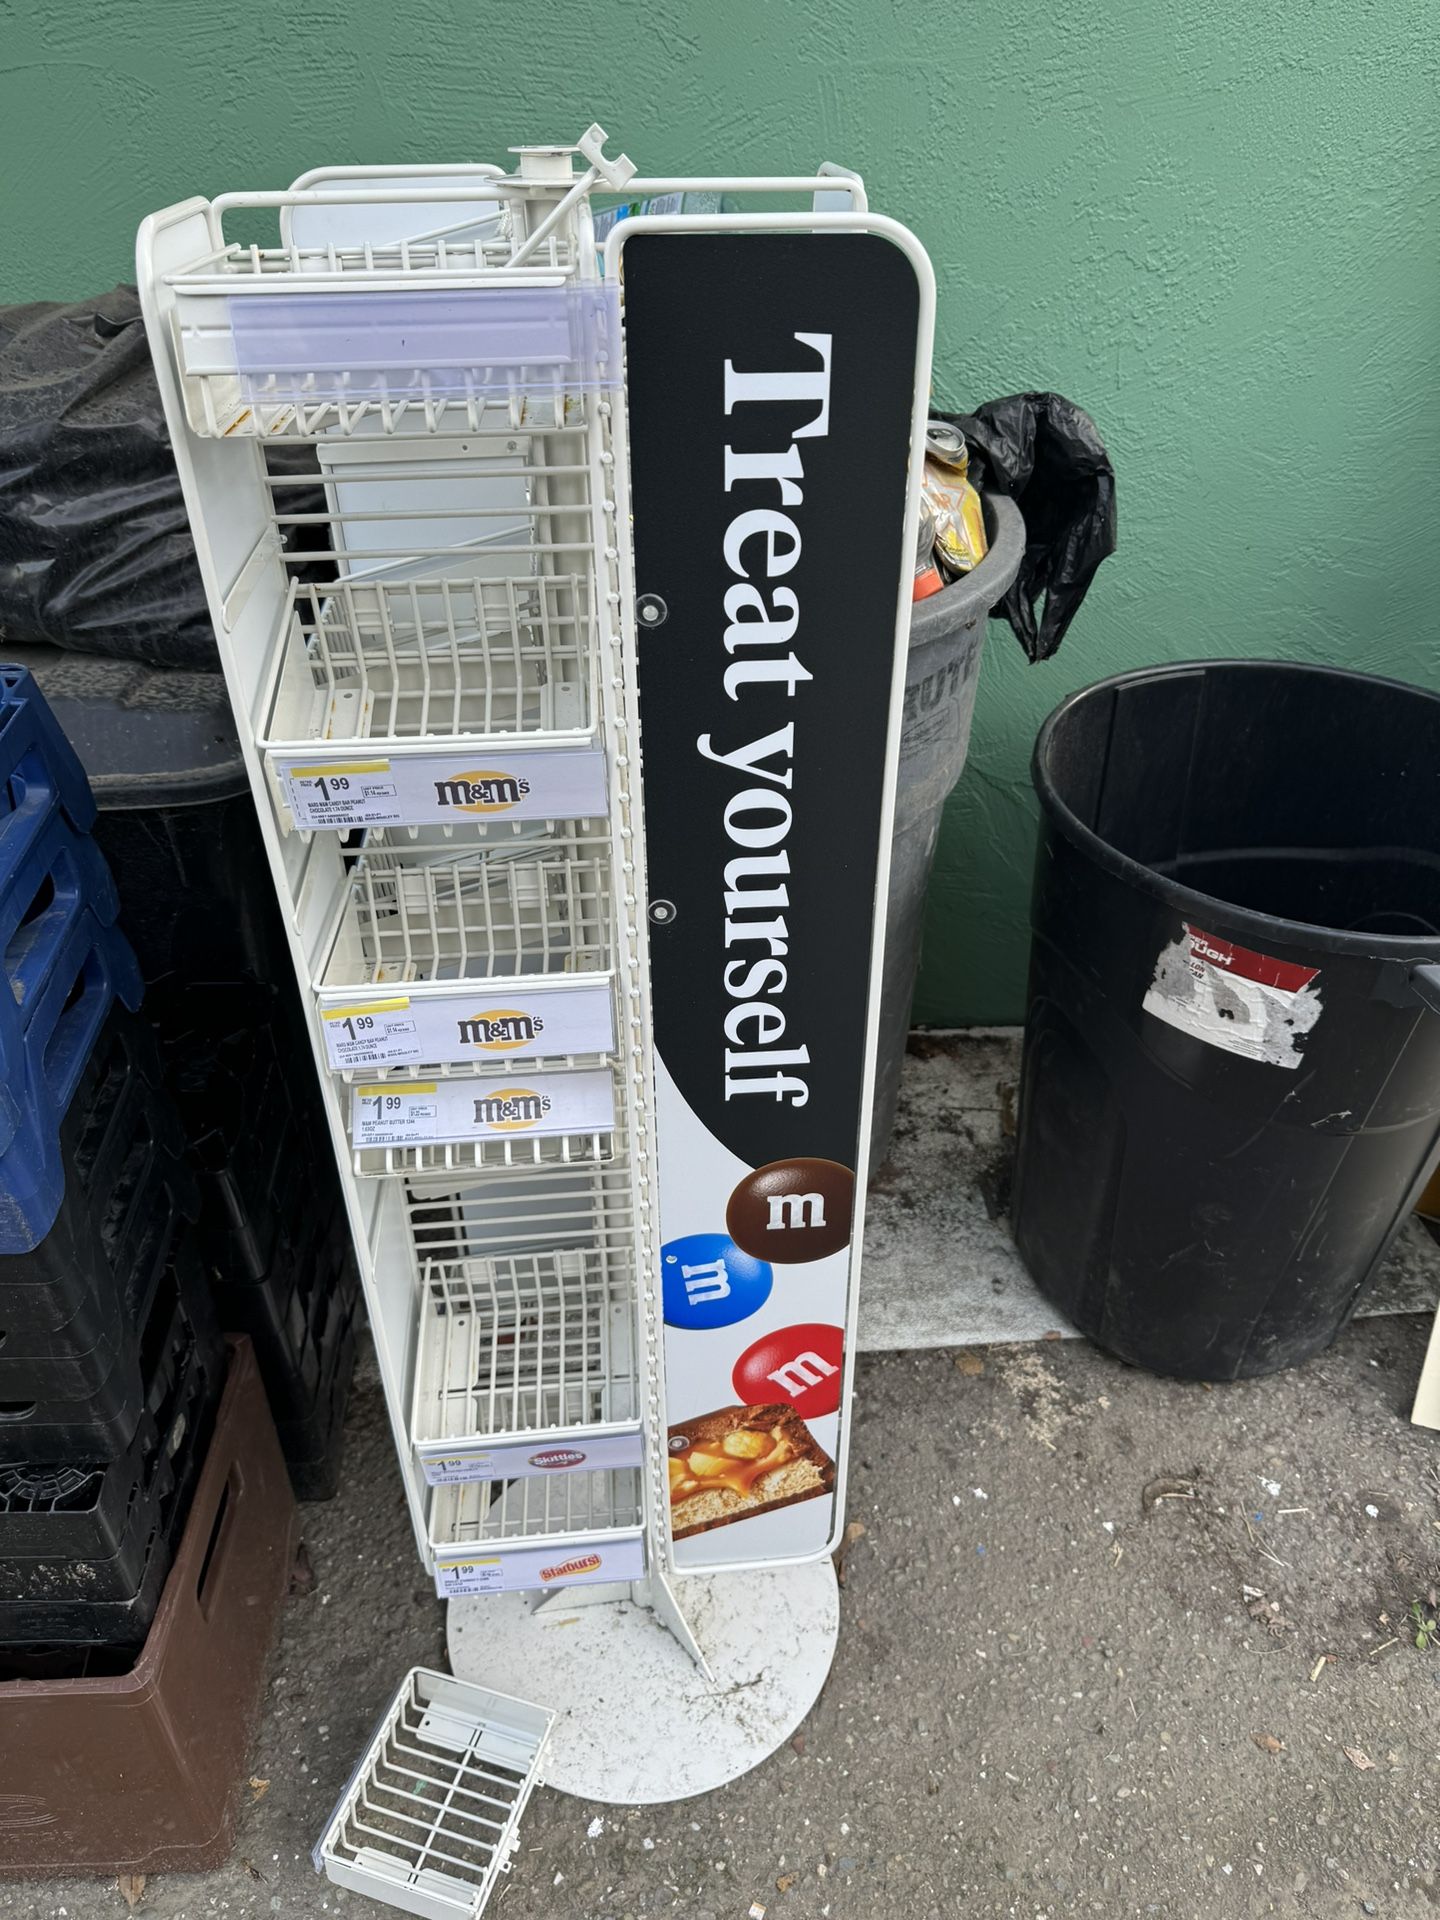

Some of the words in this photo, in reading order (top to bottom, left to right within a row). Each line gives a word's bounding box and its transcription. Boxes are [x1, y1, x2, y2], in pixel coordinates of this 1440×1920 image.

[723, 331, 832, 701] Treat
[314, 777, 330, 800] 1
[330, 777, 350, 790] 99
[697, 721, 810, 1107] yourself
[342, 1017, 356, 1040] 1
[357, 1016, 374, 1029] 99
[372, 1095, 382, 1119] 1
[386, 1096, 401, 1110] 99
[534, 1453, 583, 1465] Skittles
[451, 1566, 460, 1580] 1
[462, 1566, 474, 1574] 99
[541, 1553, 600, 1579] Starburst
